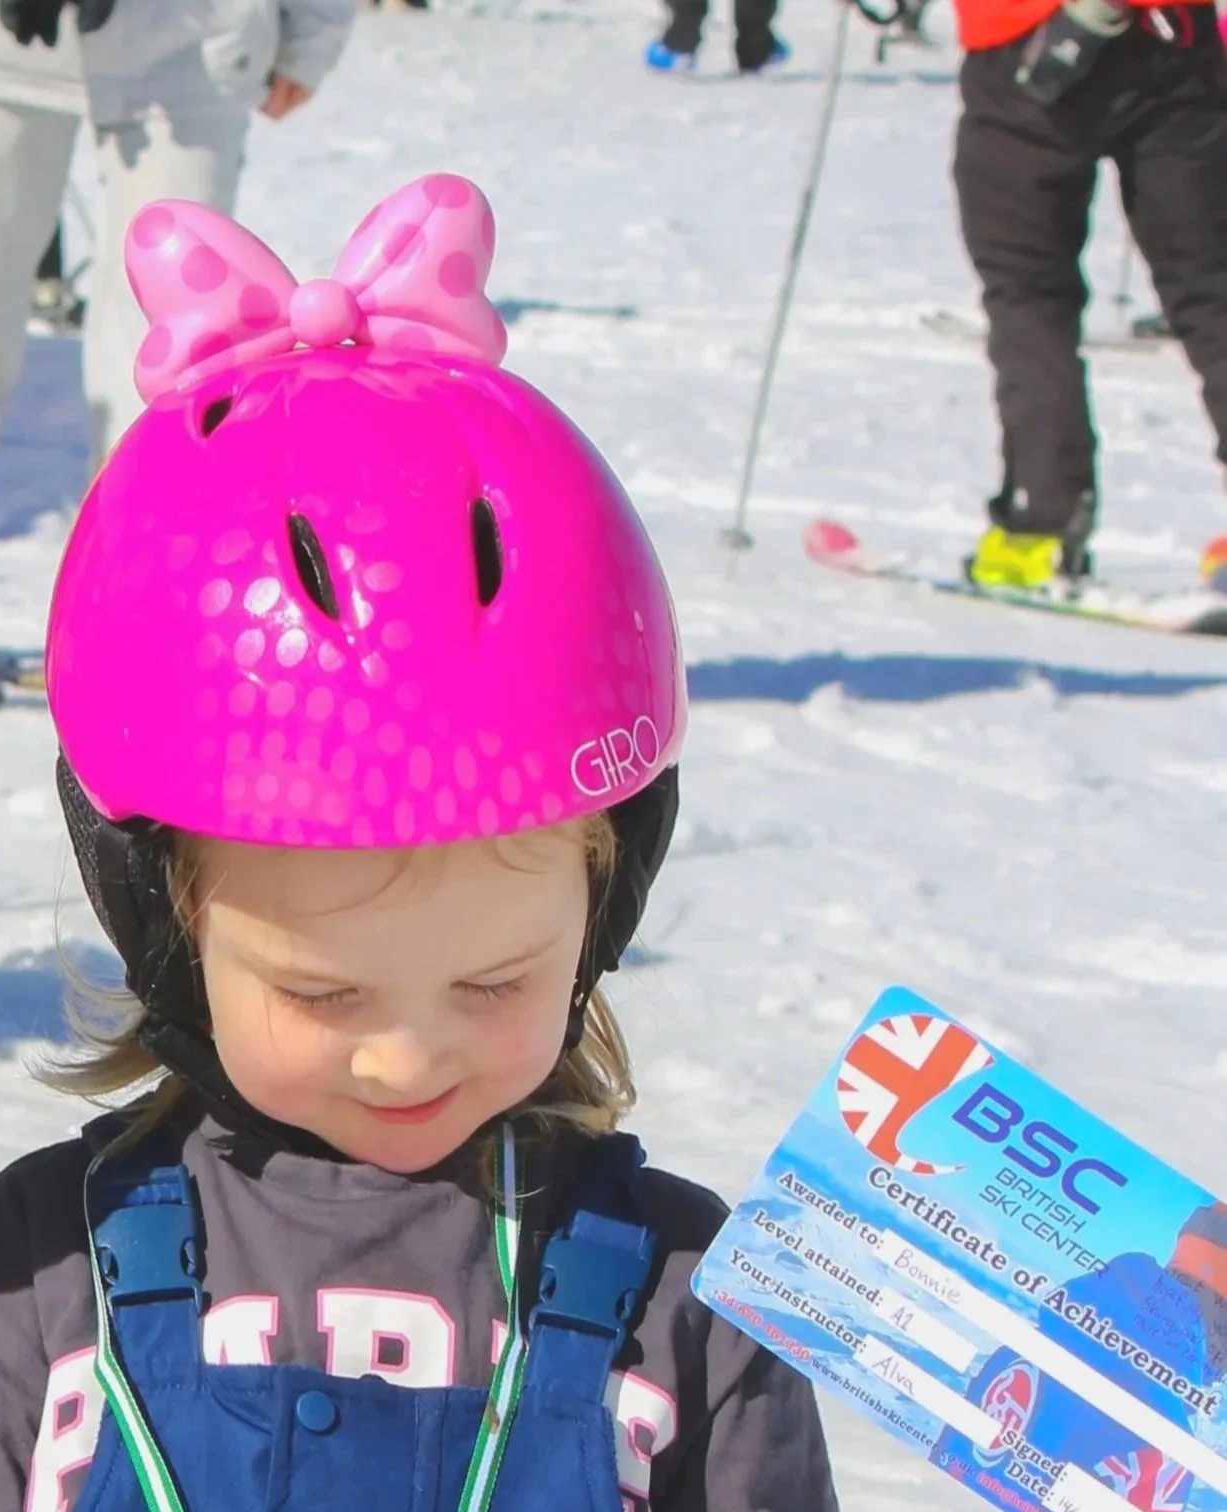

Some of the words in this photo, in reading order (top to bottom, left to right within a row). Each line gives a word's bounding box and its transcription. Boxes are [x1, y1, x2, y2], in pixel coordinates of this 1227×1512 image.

[570, 714, 660, 796] GIRO
[950, 1081, 1130, 1216] BSC
[778, 1172, 857, 1231] Awarded
[859, 1224, 884, 1250] to:
[978, 1184, 1022, 1219] SKI
[1020, 1214, 1111, 1278] CENTER
[994, 1166, 1088, 1234] BRITISH
[753, 1210, 804, 1250] Level
[803, 1247, 884, 1307] attained:
[868, 1166, 1008, 1272] Certificate
[1013, 1267, 1049, 1295] of
[1043, 1289, 1219, 1416] Achievement
[893, 1247, 963, 1305] Bonnie
[729, 1249, 772, 1287] Your
[773, 1281, 868, 1354] instructor:
[872, 1355, 915, 1396] Alva
[1002, 1429, 1069, 1482] Signed:
[1006, 1461, 1055, 1502] Date:
